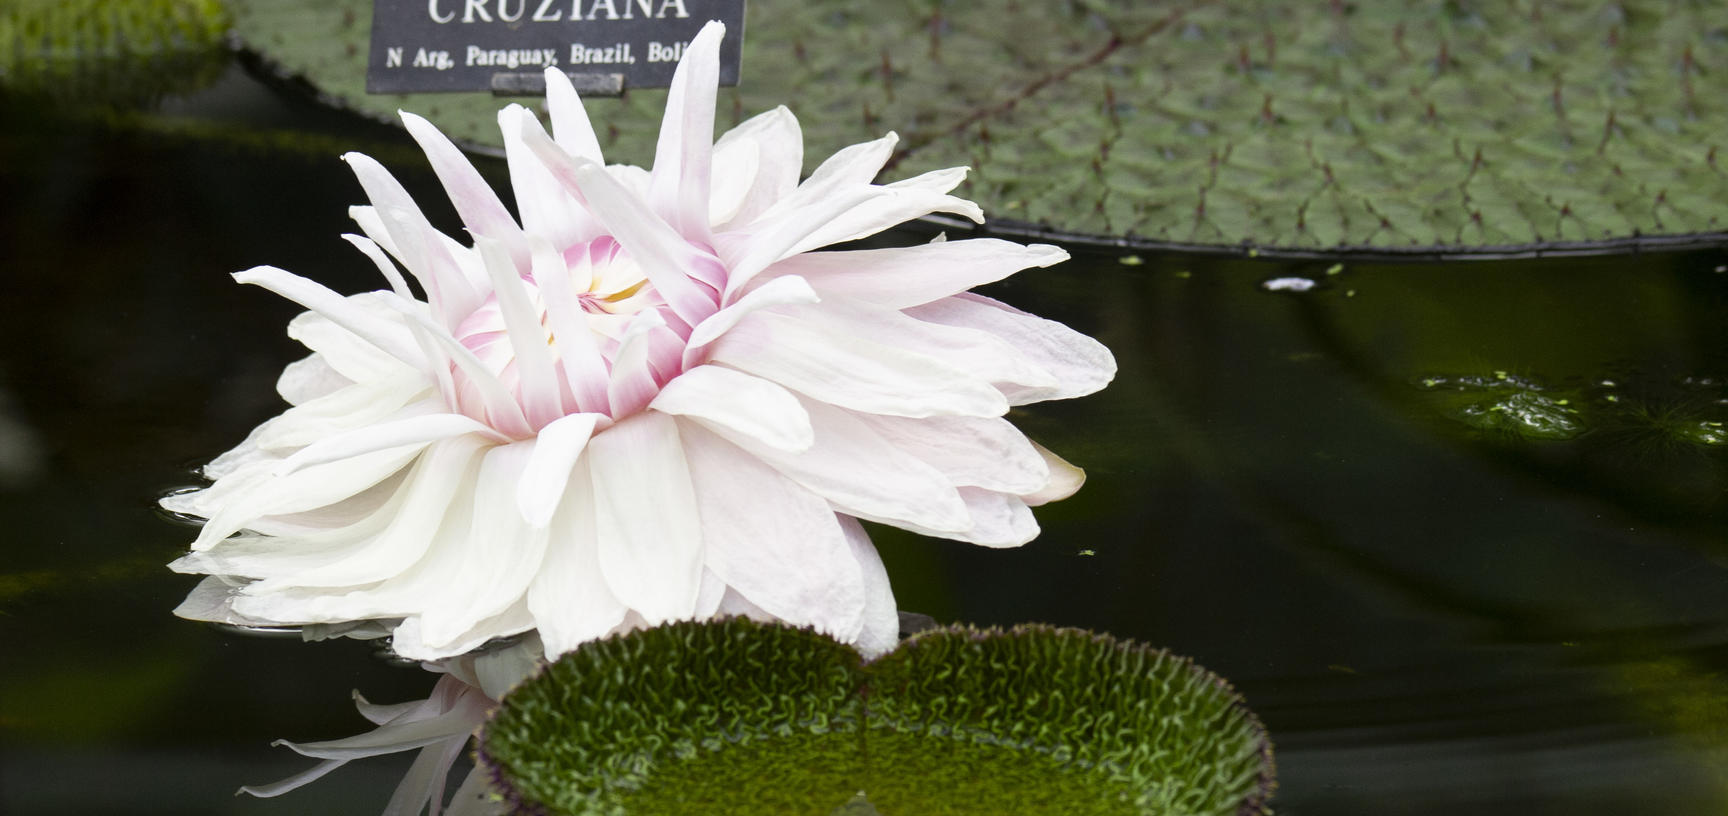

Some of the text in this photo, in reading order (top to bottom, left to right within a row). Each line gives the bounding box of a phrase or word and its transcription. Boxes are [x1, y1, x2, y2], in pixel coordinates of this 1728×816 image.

[428, 0, 691, 24] CRUZIANA
[386, 47, 404, 68] N
[570, 43, 636, 65] Brazil,
[647, 41, 688, 63] Boli
